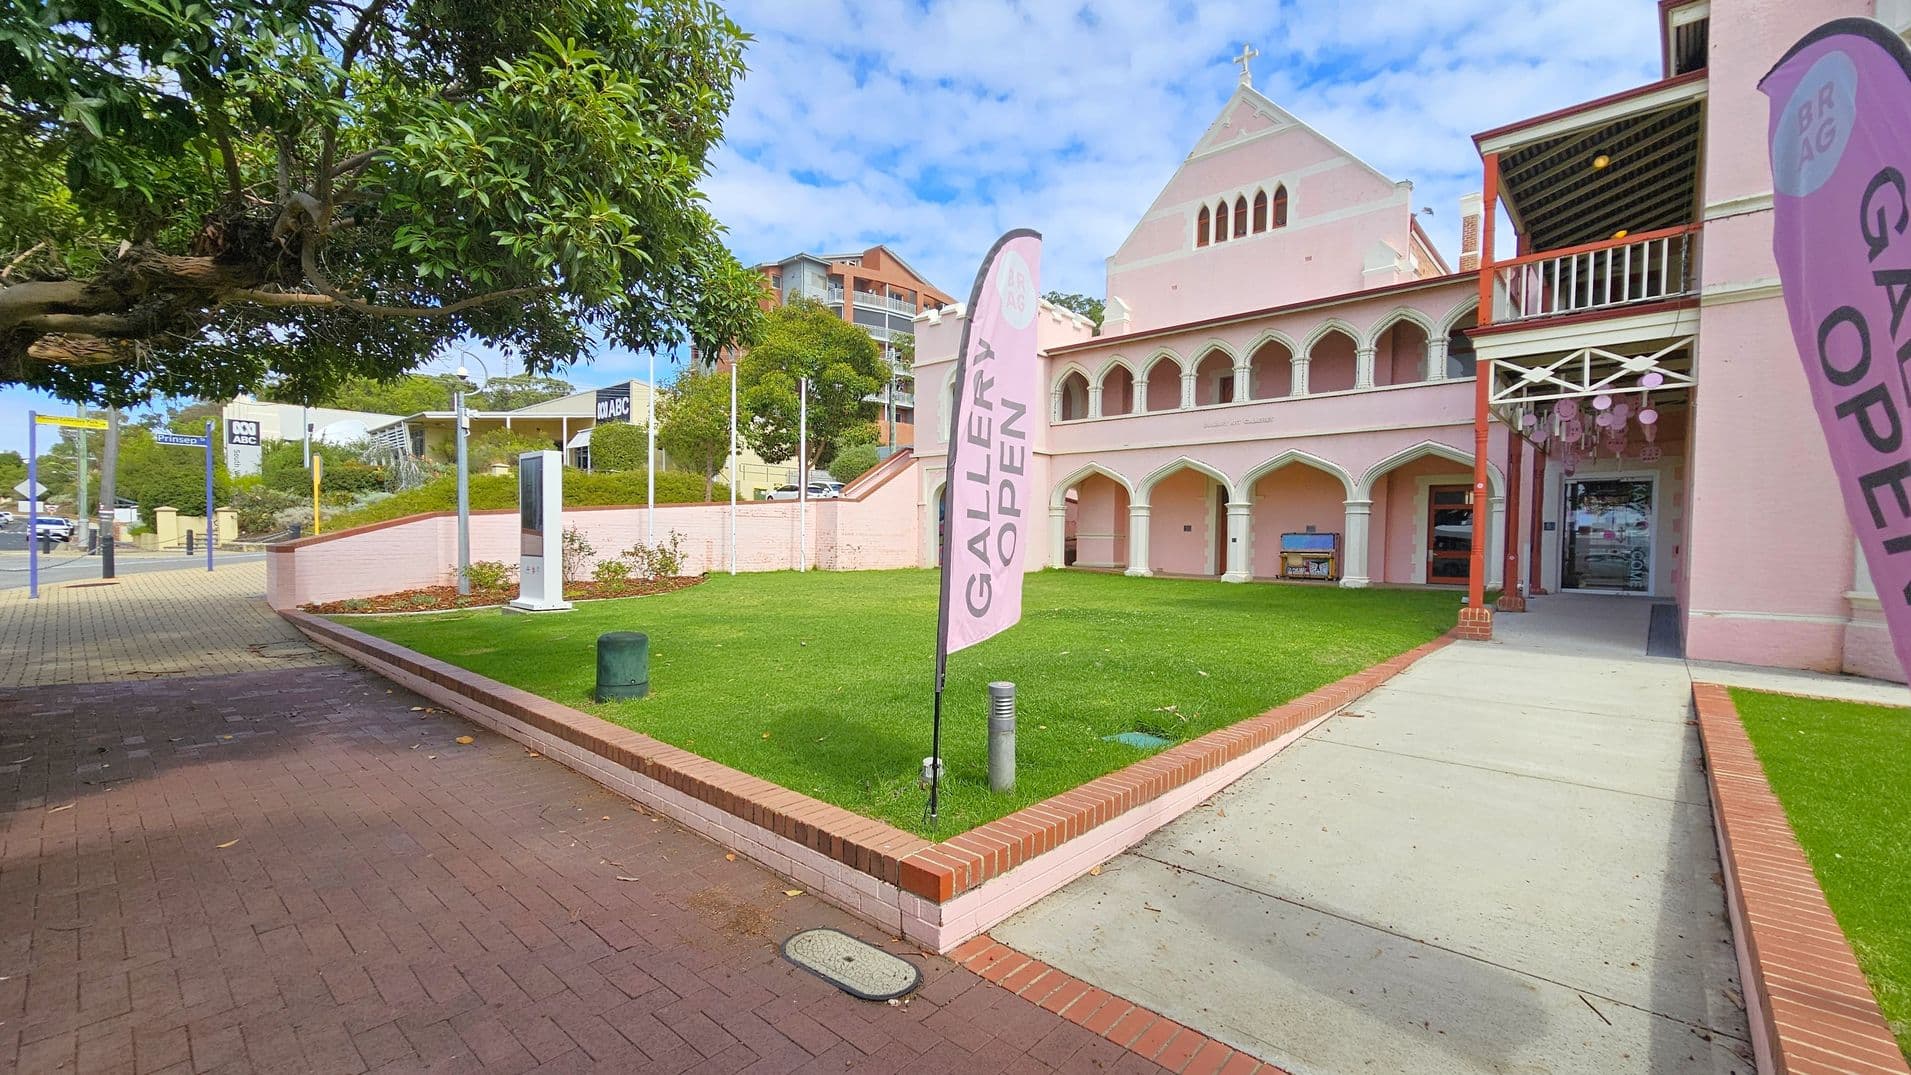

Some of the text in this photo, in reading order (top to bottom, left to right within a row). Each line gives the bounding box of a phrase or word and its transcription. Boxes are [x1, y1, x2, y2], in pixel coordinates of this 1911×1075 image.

[608, 396, 630, 418] ABC
[158, 434, 198, 445] Prinsep
[232, 435, 257, 445] ABC
[233, 448, 241, 468] South
[1817, 305, 1911, 605] OPE
[966, 336, 996, 619] GALLERY
[999, 396, 1027, 567] OPEN
